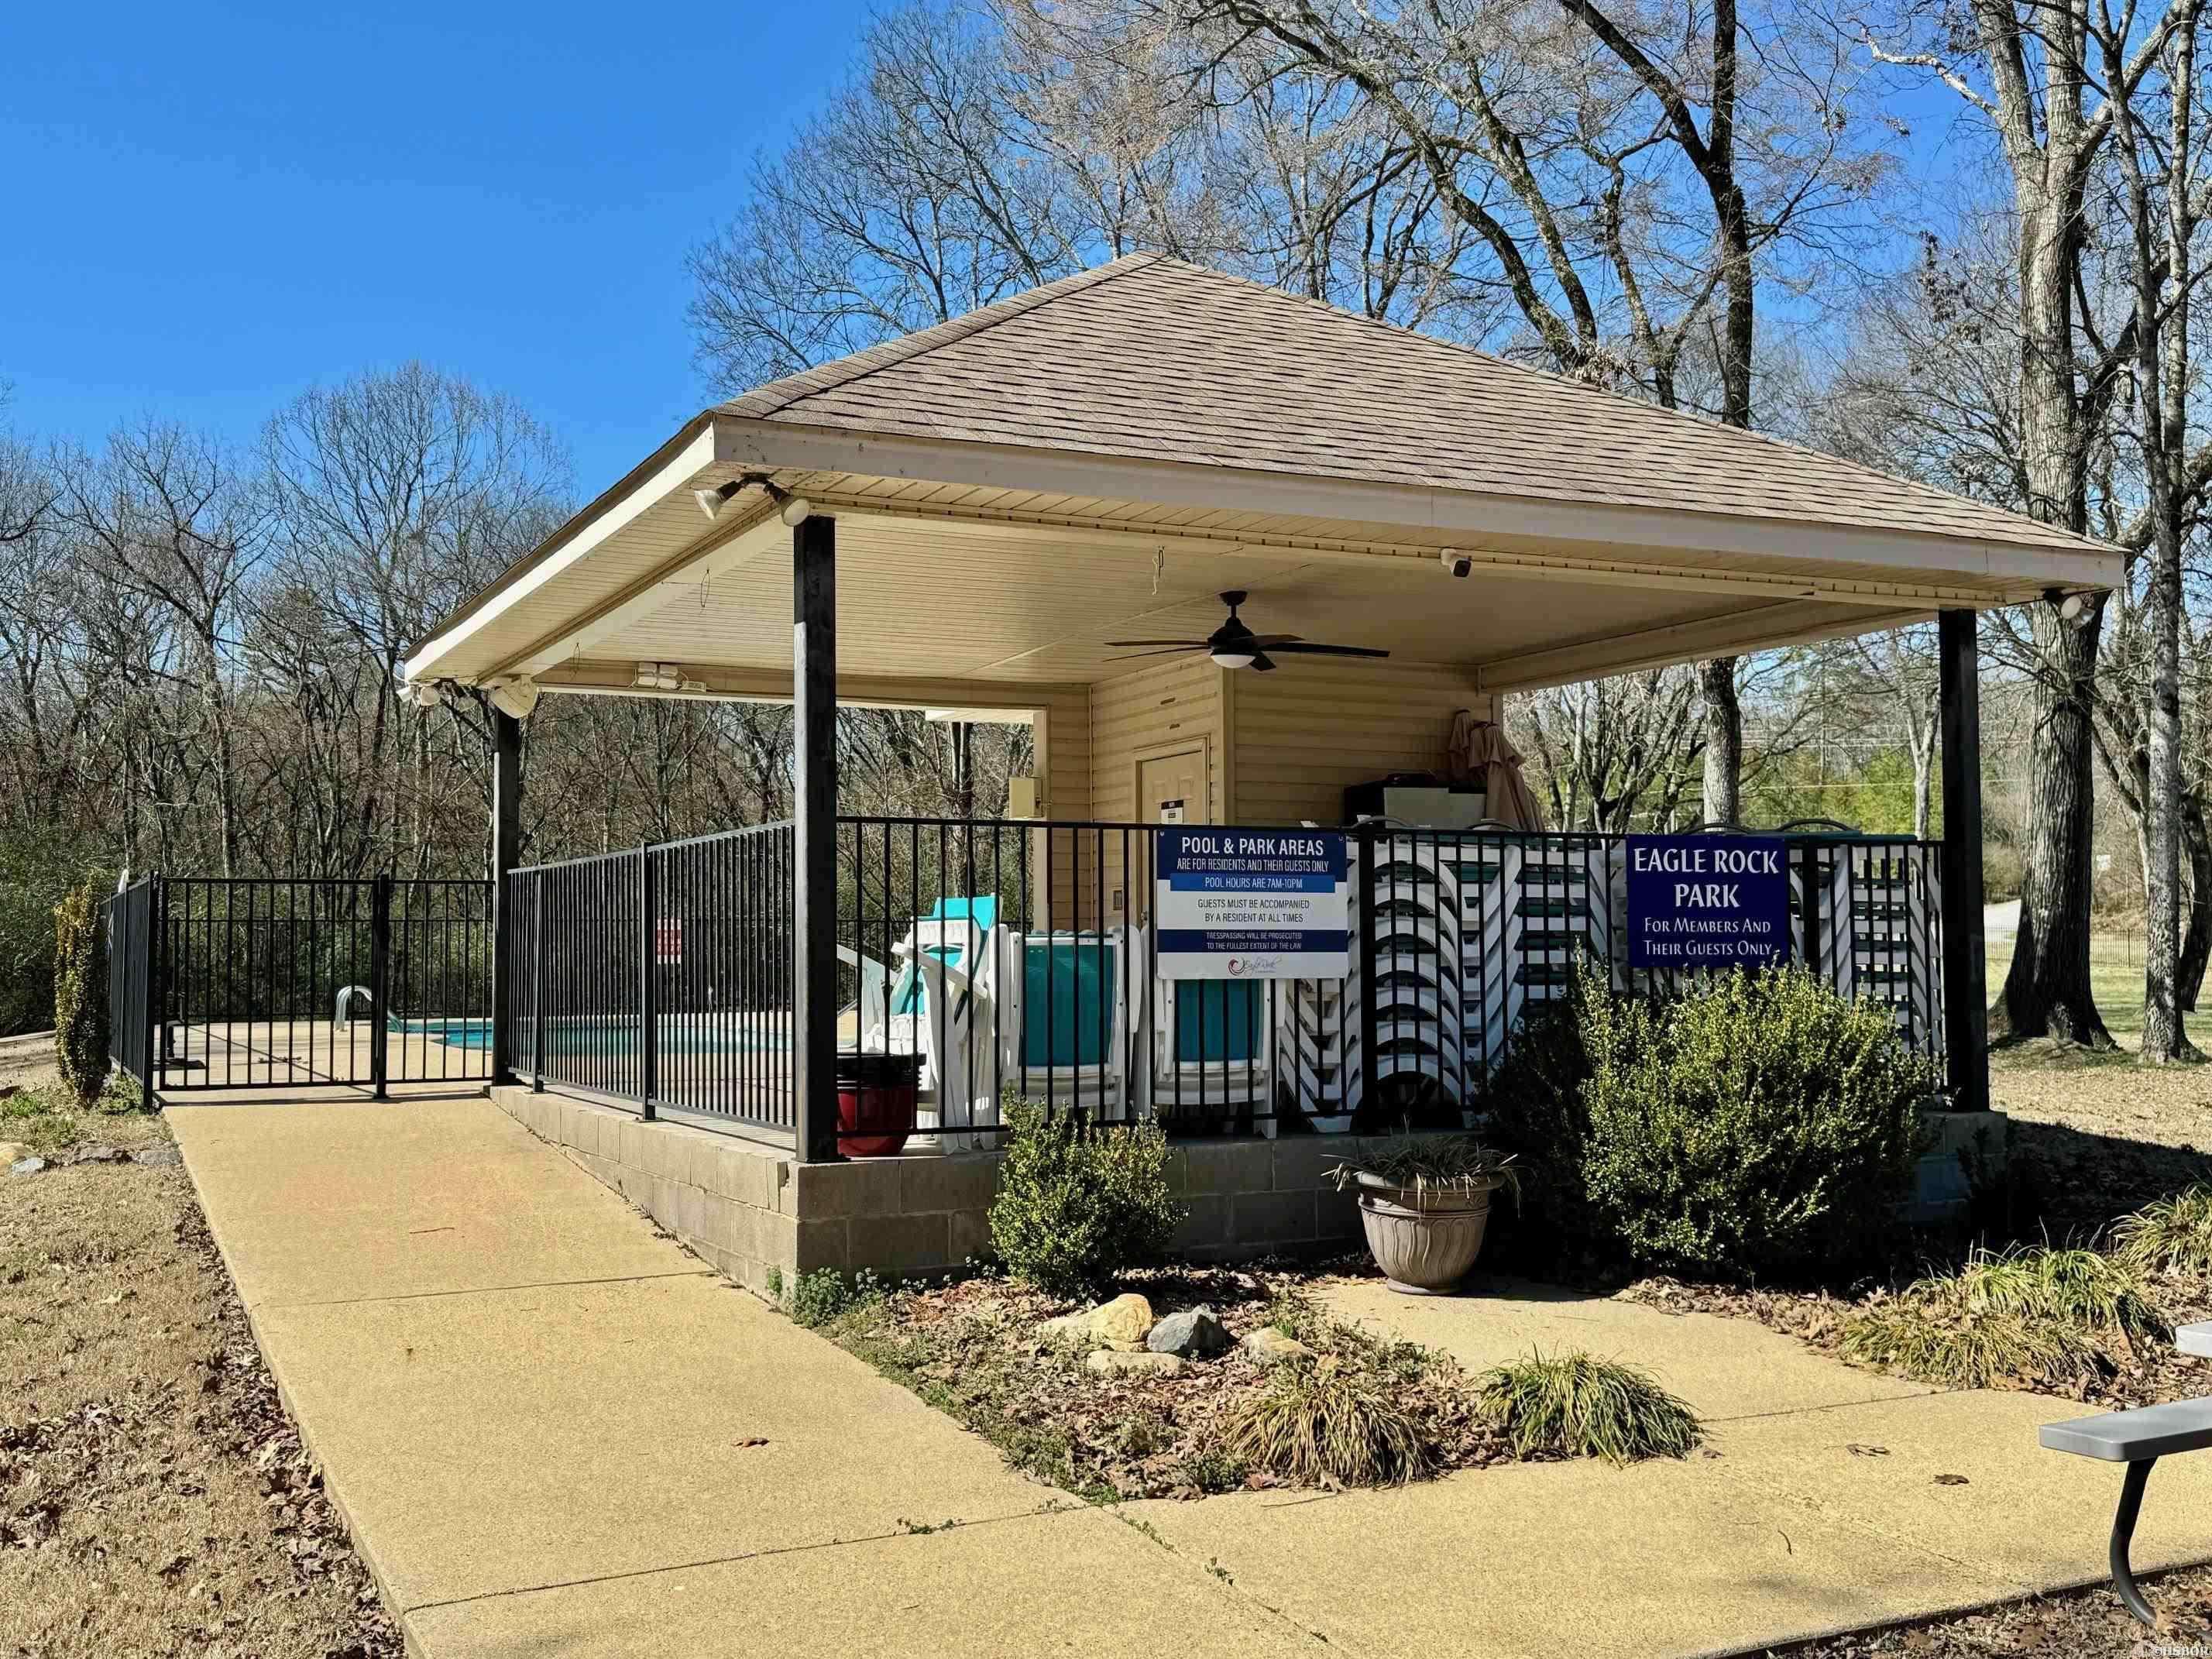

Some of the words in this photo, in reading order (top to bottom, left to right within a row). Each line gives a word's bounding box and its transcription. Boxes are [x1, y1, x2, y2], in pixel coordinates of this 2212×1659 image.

[1182, 836, 1219, 854] POOL
[1224, 838, 1234, 854] &
[1239, 838, 1275, 855] PARK
[1279, 839, 1324, 856] AREAS
[1177, 857, 1190, 870] ARE
[1192, 857, 1207, 870] FOR
[1208, 857, 1245, 871] RESIDENTS
[1247, 859, 1262, 871] AND
[1263, 859, 1283, 871] THEIR
[1285, 860, 1310, 872] GUESTS
[1312, 860, 1329, 872] ONLY
[1633, 847, 1708, 873] EAGLE
[1714, 849, 1779, 874] ROCK
[1205, 877, 1224, 888] POOL
[1226, 877, 1250, 888] HOURS
[1252, 878, 1266, 888] ARE
[1267, 878, 1303, 888] 7AM-10PM
[1674, 883, 1740, 908] PARK
[1197, 899, 1225, 908] GUESTS
[1228, 899, 1247, 908] MUST
[1249, 899, 1258, 908] BE
[1259, 899, 1310, 908] ACCOMPANIED
[1205, 913, 1214, 922] BY
[1216, 913, 1221, 922] A
[1223, 913, 1257, 922] RESIDENT
[1259, 913, 1266, 922] AT
[1268, 913, 1282, 922] ALL
[1283, 913, 1304, 922] TIMES
